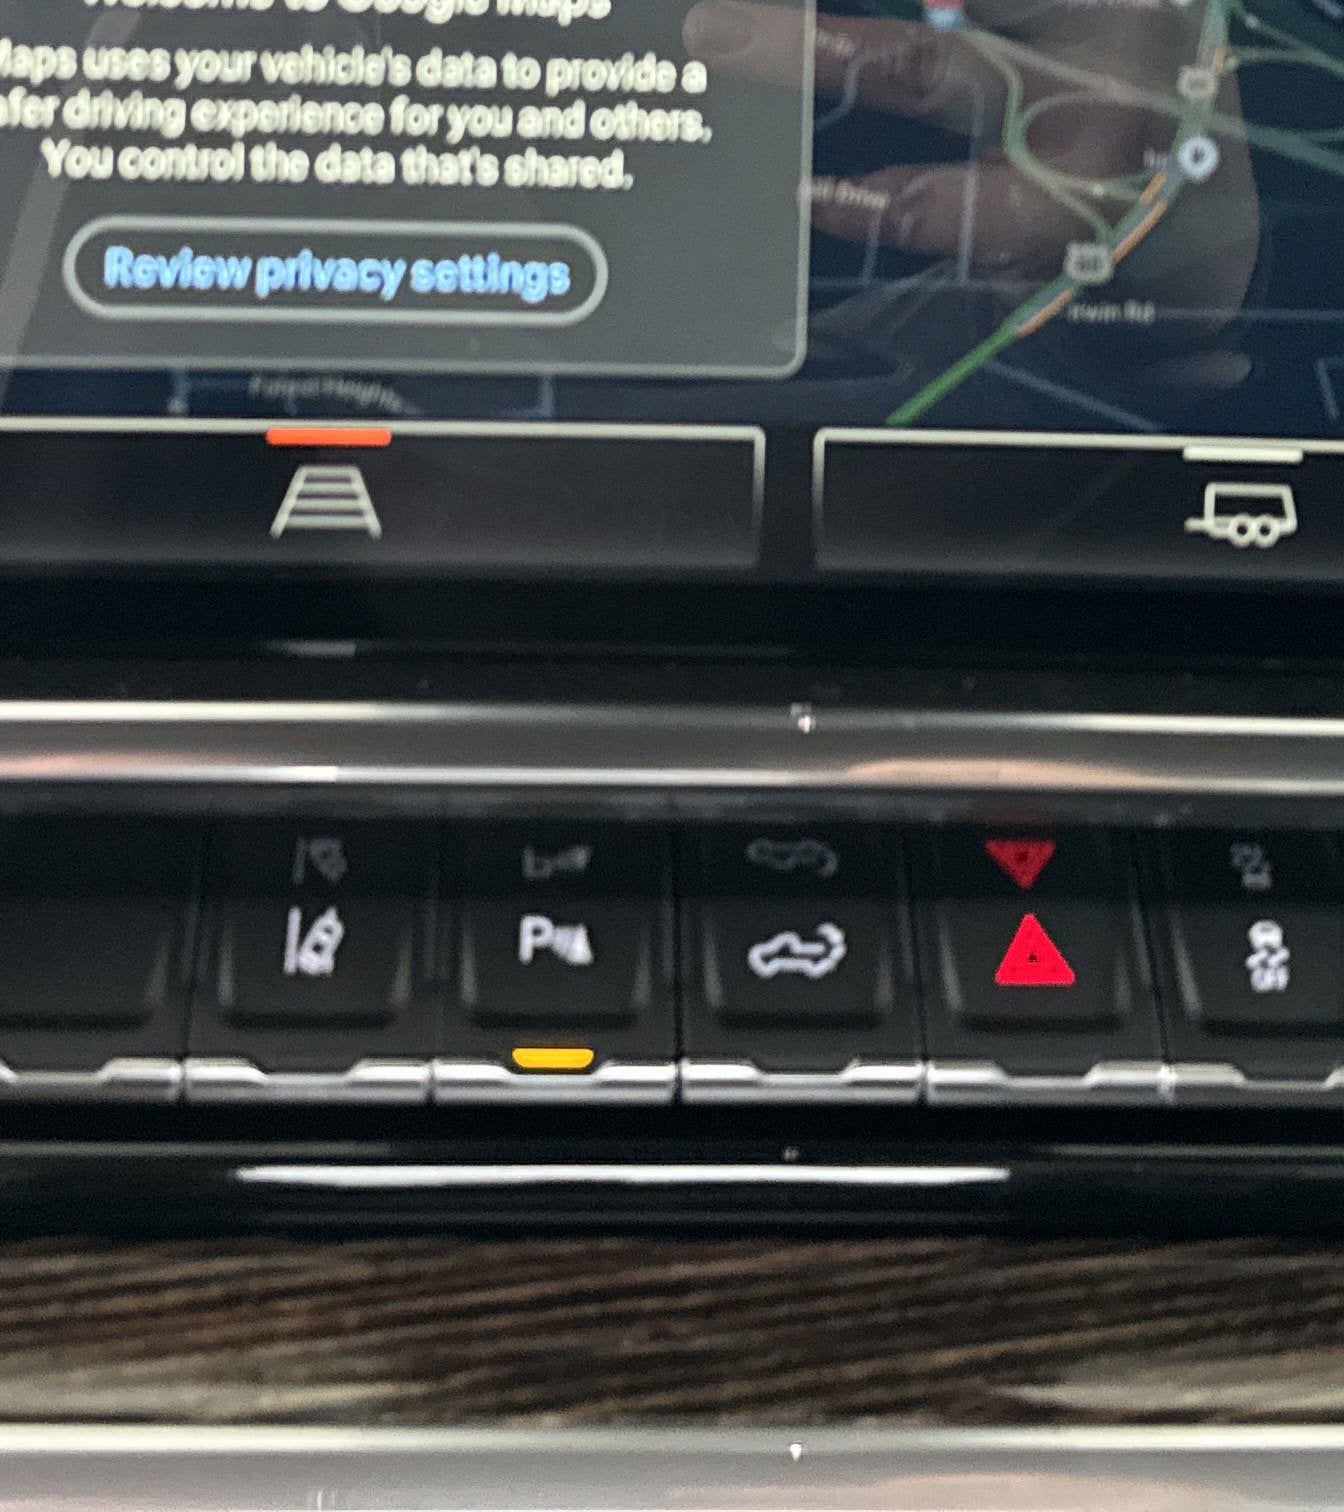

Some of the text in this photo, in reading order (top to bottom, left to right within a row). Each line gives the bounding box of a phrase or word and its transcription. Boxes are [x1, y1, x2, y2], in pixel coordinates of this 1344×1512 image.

[82, 45, 172, 82] uses
[174, 47, 257, 91] your
[260, 43, 413, 87] vehicle's
[415, 46, 498, 90] data
[502, 52, 542, 91] to
[545, 51, 678, 98] provide
[681, 60, 708, 94] a
[62, 88, 187, 139] driving
[191, 94, 386, 139] experience
[390, 93, 445, 137] for
[446, 102, 514, 144] you
[516, 98, 587, 140] and
[589, 100, 713, 144] others.
[40, 136, 635, 190] You control the data that's shared.
[102, 244, 572, 305] Review privacy settings
